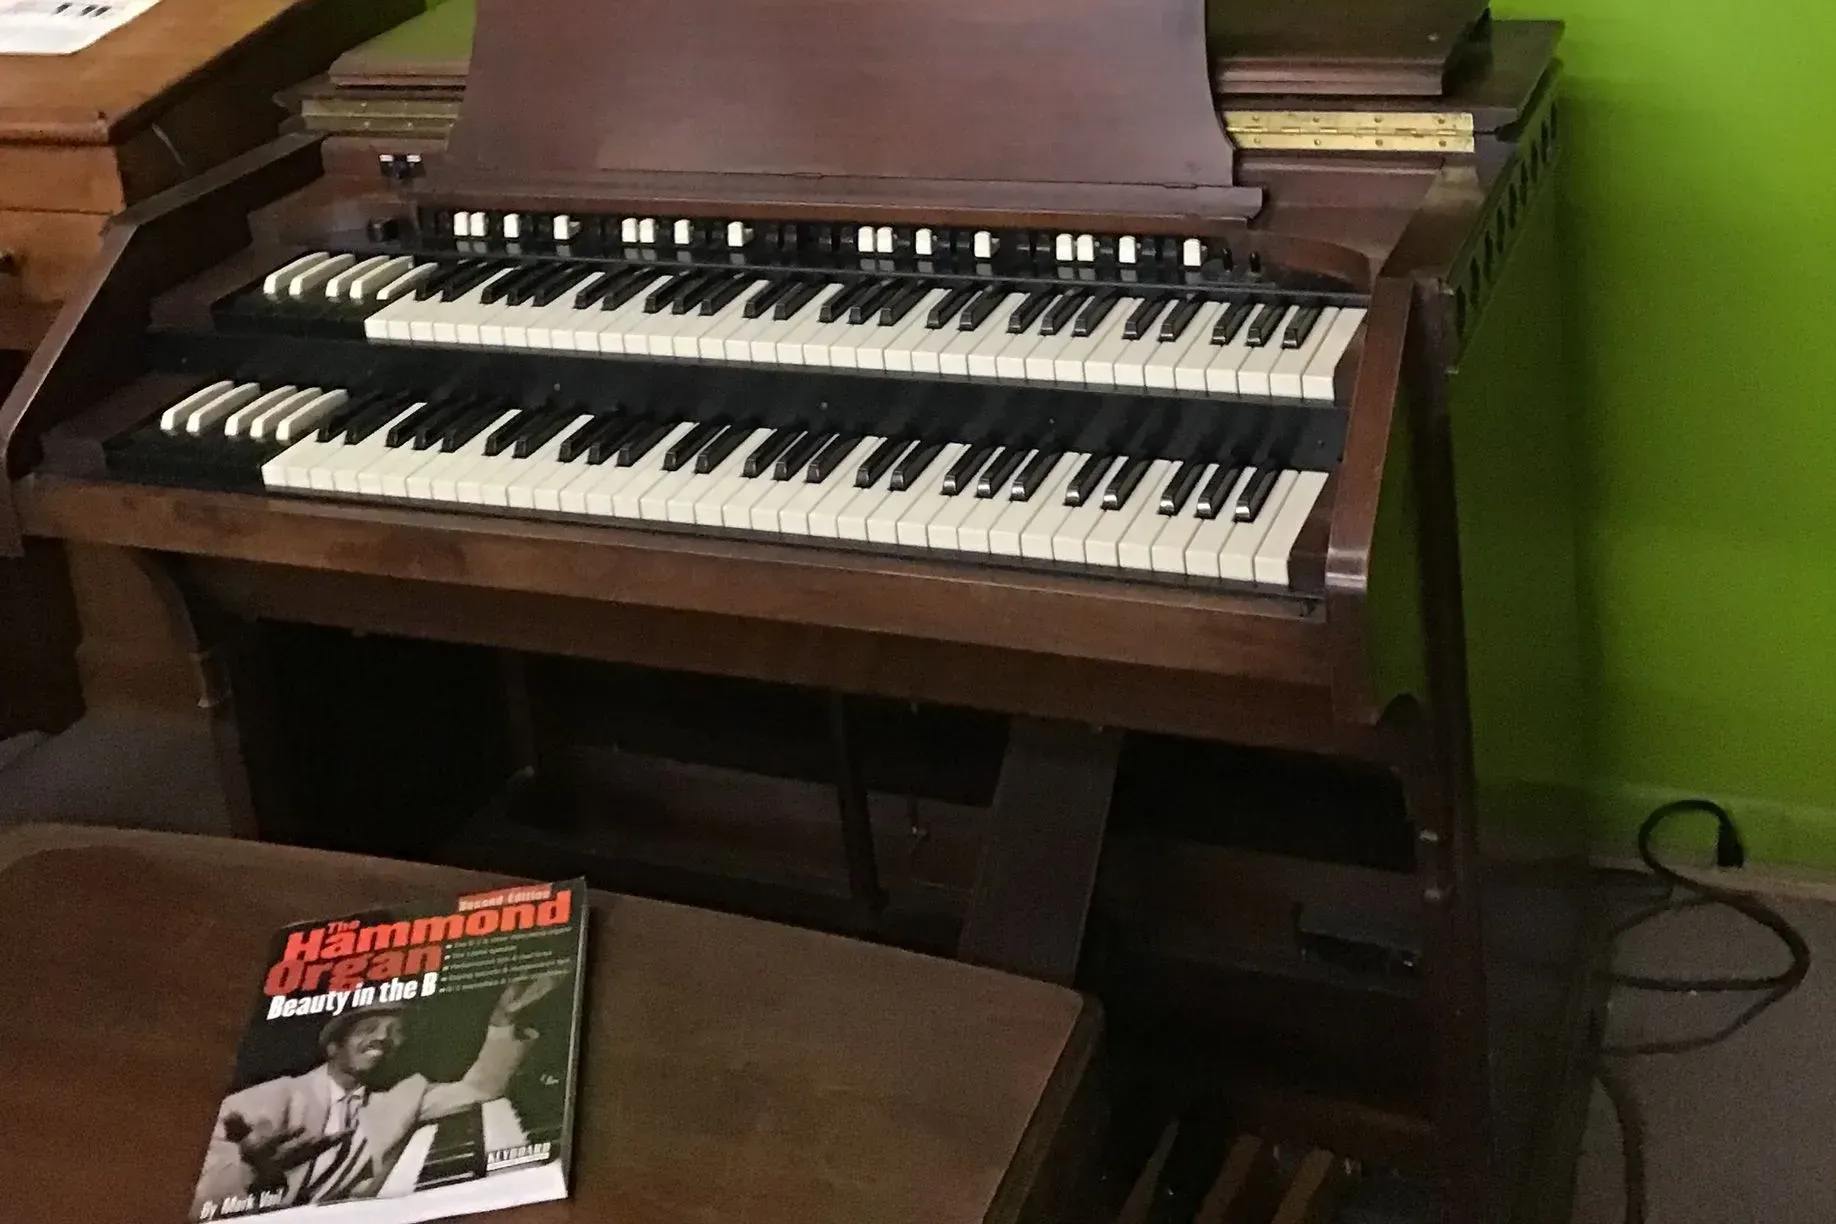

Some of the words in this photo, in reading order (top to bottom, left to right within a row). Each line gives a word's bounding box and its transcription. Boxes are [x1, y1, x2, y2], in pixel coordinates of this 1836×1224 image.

[282, 889, 572, 963] Hammond
[266, 988, 352, 1021] Beauty
[351, 981, 375, 1008] in
[379, 977, 418, 1003] the
[421, 972, 439, 997] B
